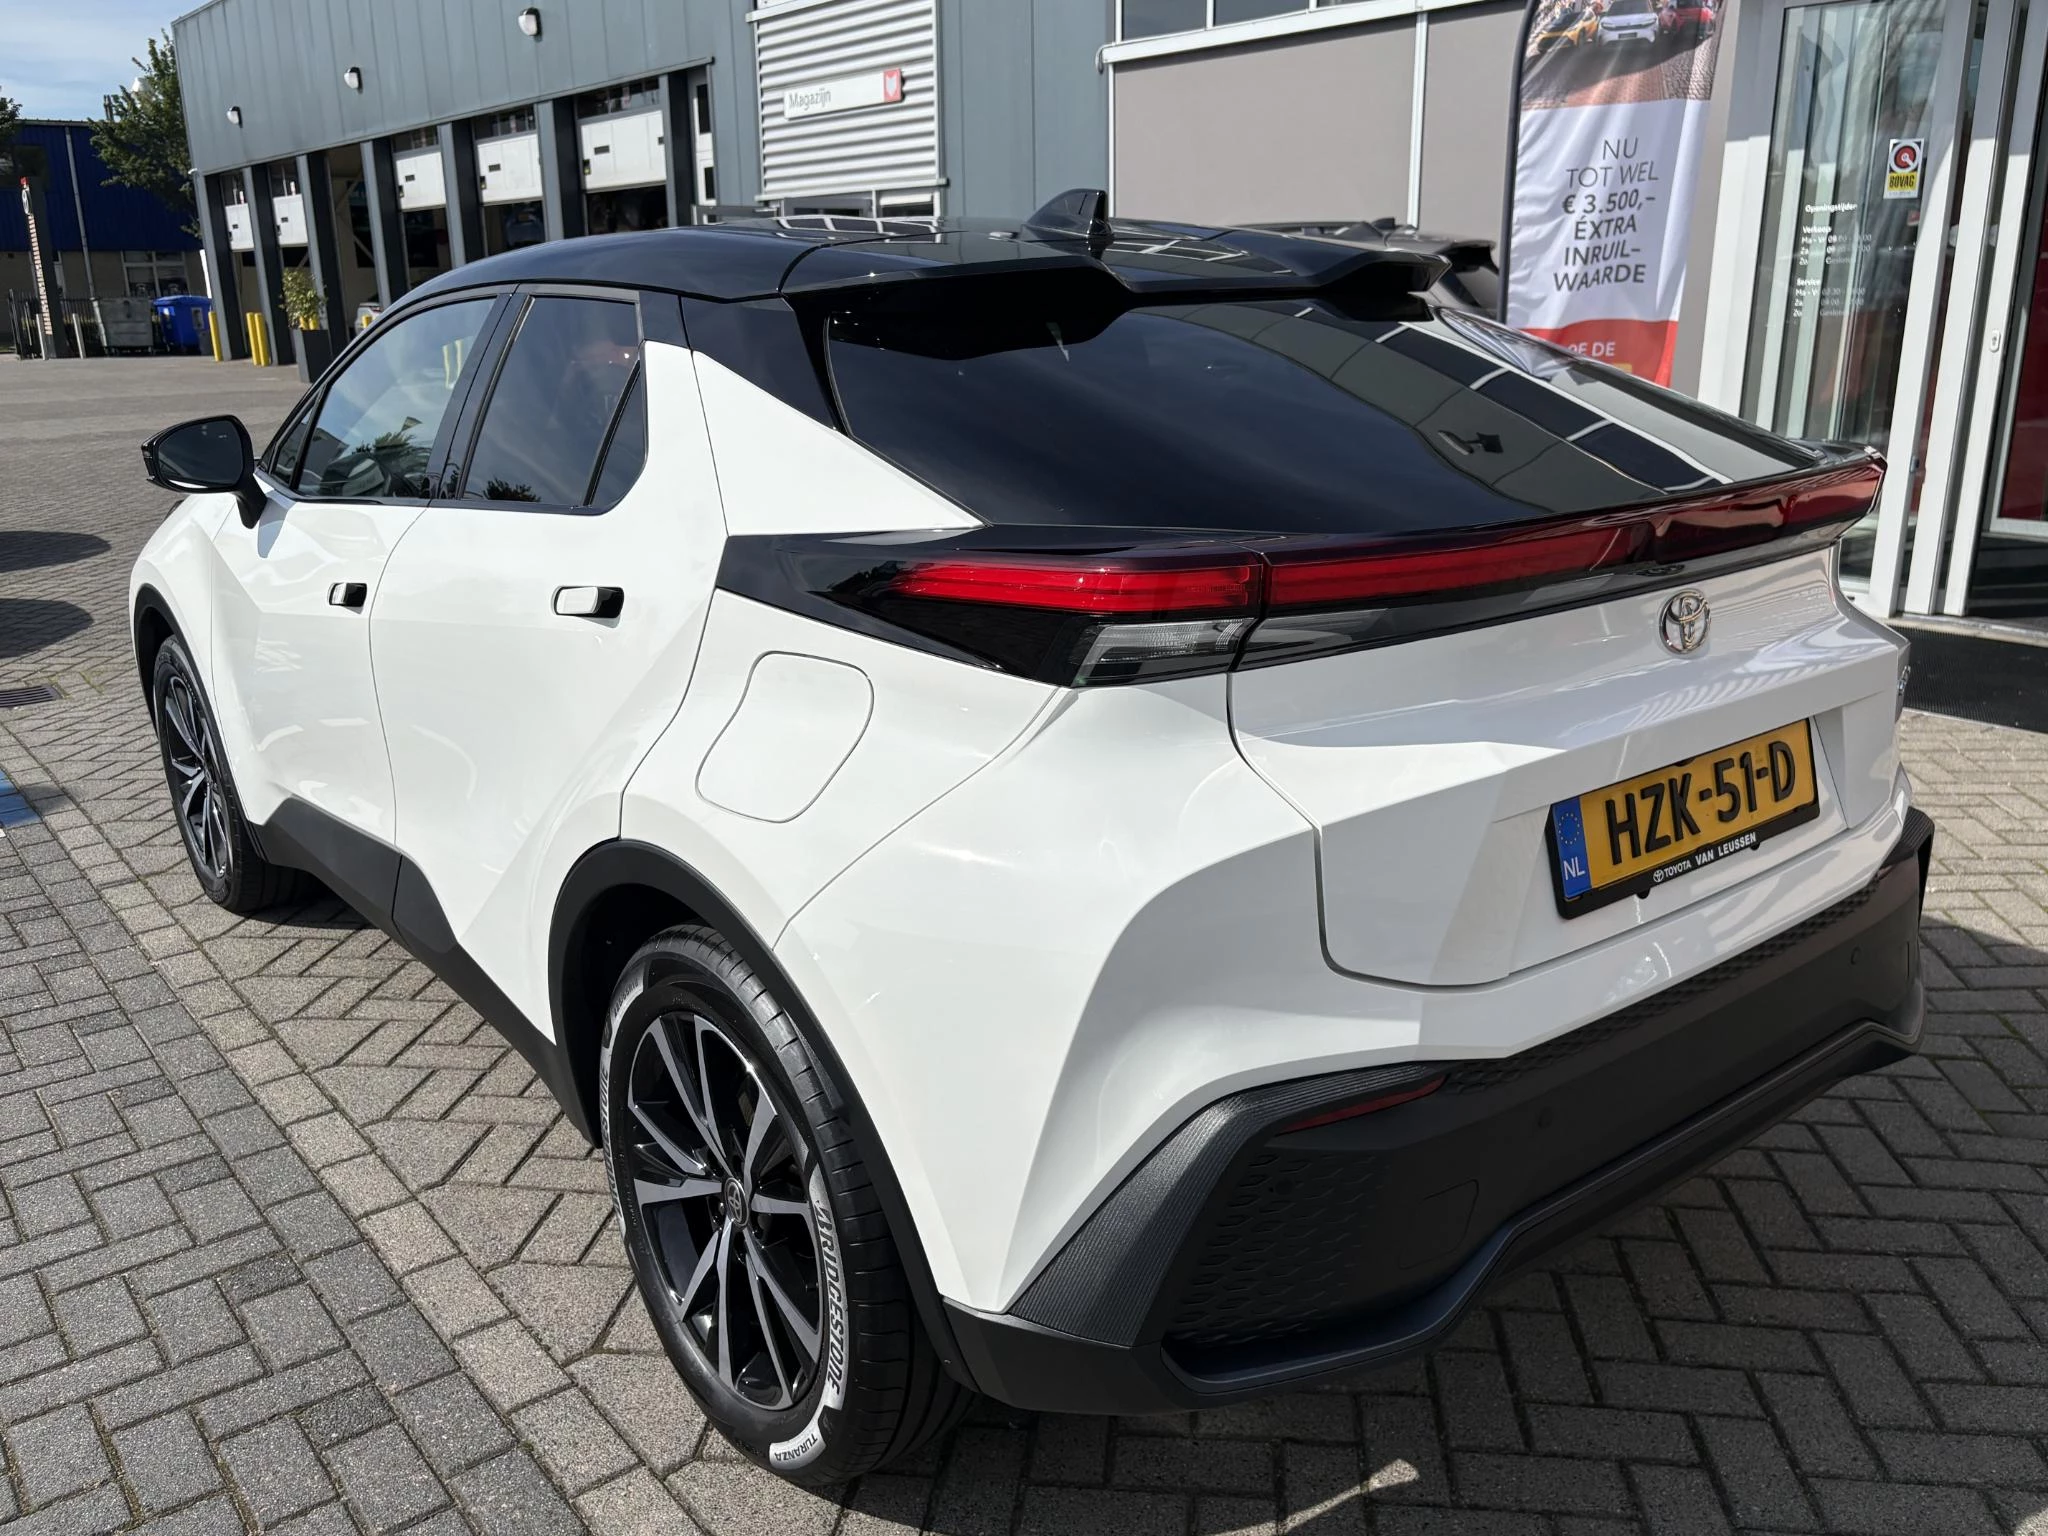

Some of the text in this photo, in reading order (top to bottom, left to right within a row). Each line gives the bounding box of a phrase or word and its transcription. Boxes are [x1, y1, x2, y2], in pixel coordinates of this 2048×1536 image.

[788, 87, 832, 111] Magazijn
[1603, 136, 1638, 160] NU
[1566, 160, 1659, 188] TOT WEL
[1889, 174, 1915, 189] BOVAG
[1574, 214, 1637, 241] ÉXTRA
[1564, 240, 1641, 266] INRUIL-
[1553, 264, 1646, 292] WAARDE
[1591, 342, 1616, 357] DE
[1605, 740, 1796, 866] HZK-51-D
[1663, 832, 1757, 878] TOYOTA VAN LEUSSEN
[1563, 859, 1585, 881] NL
[815, 1200, 845, 1396] BRIDGESTONE
[774, 1432, 818, 1462] TURANZA
